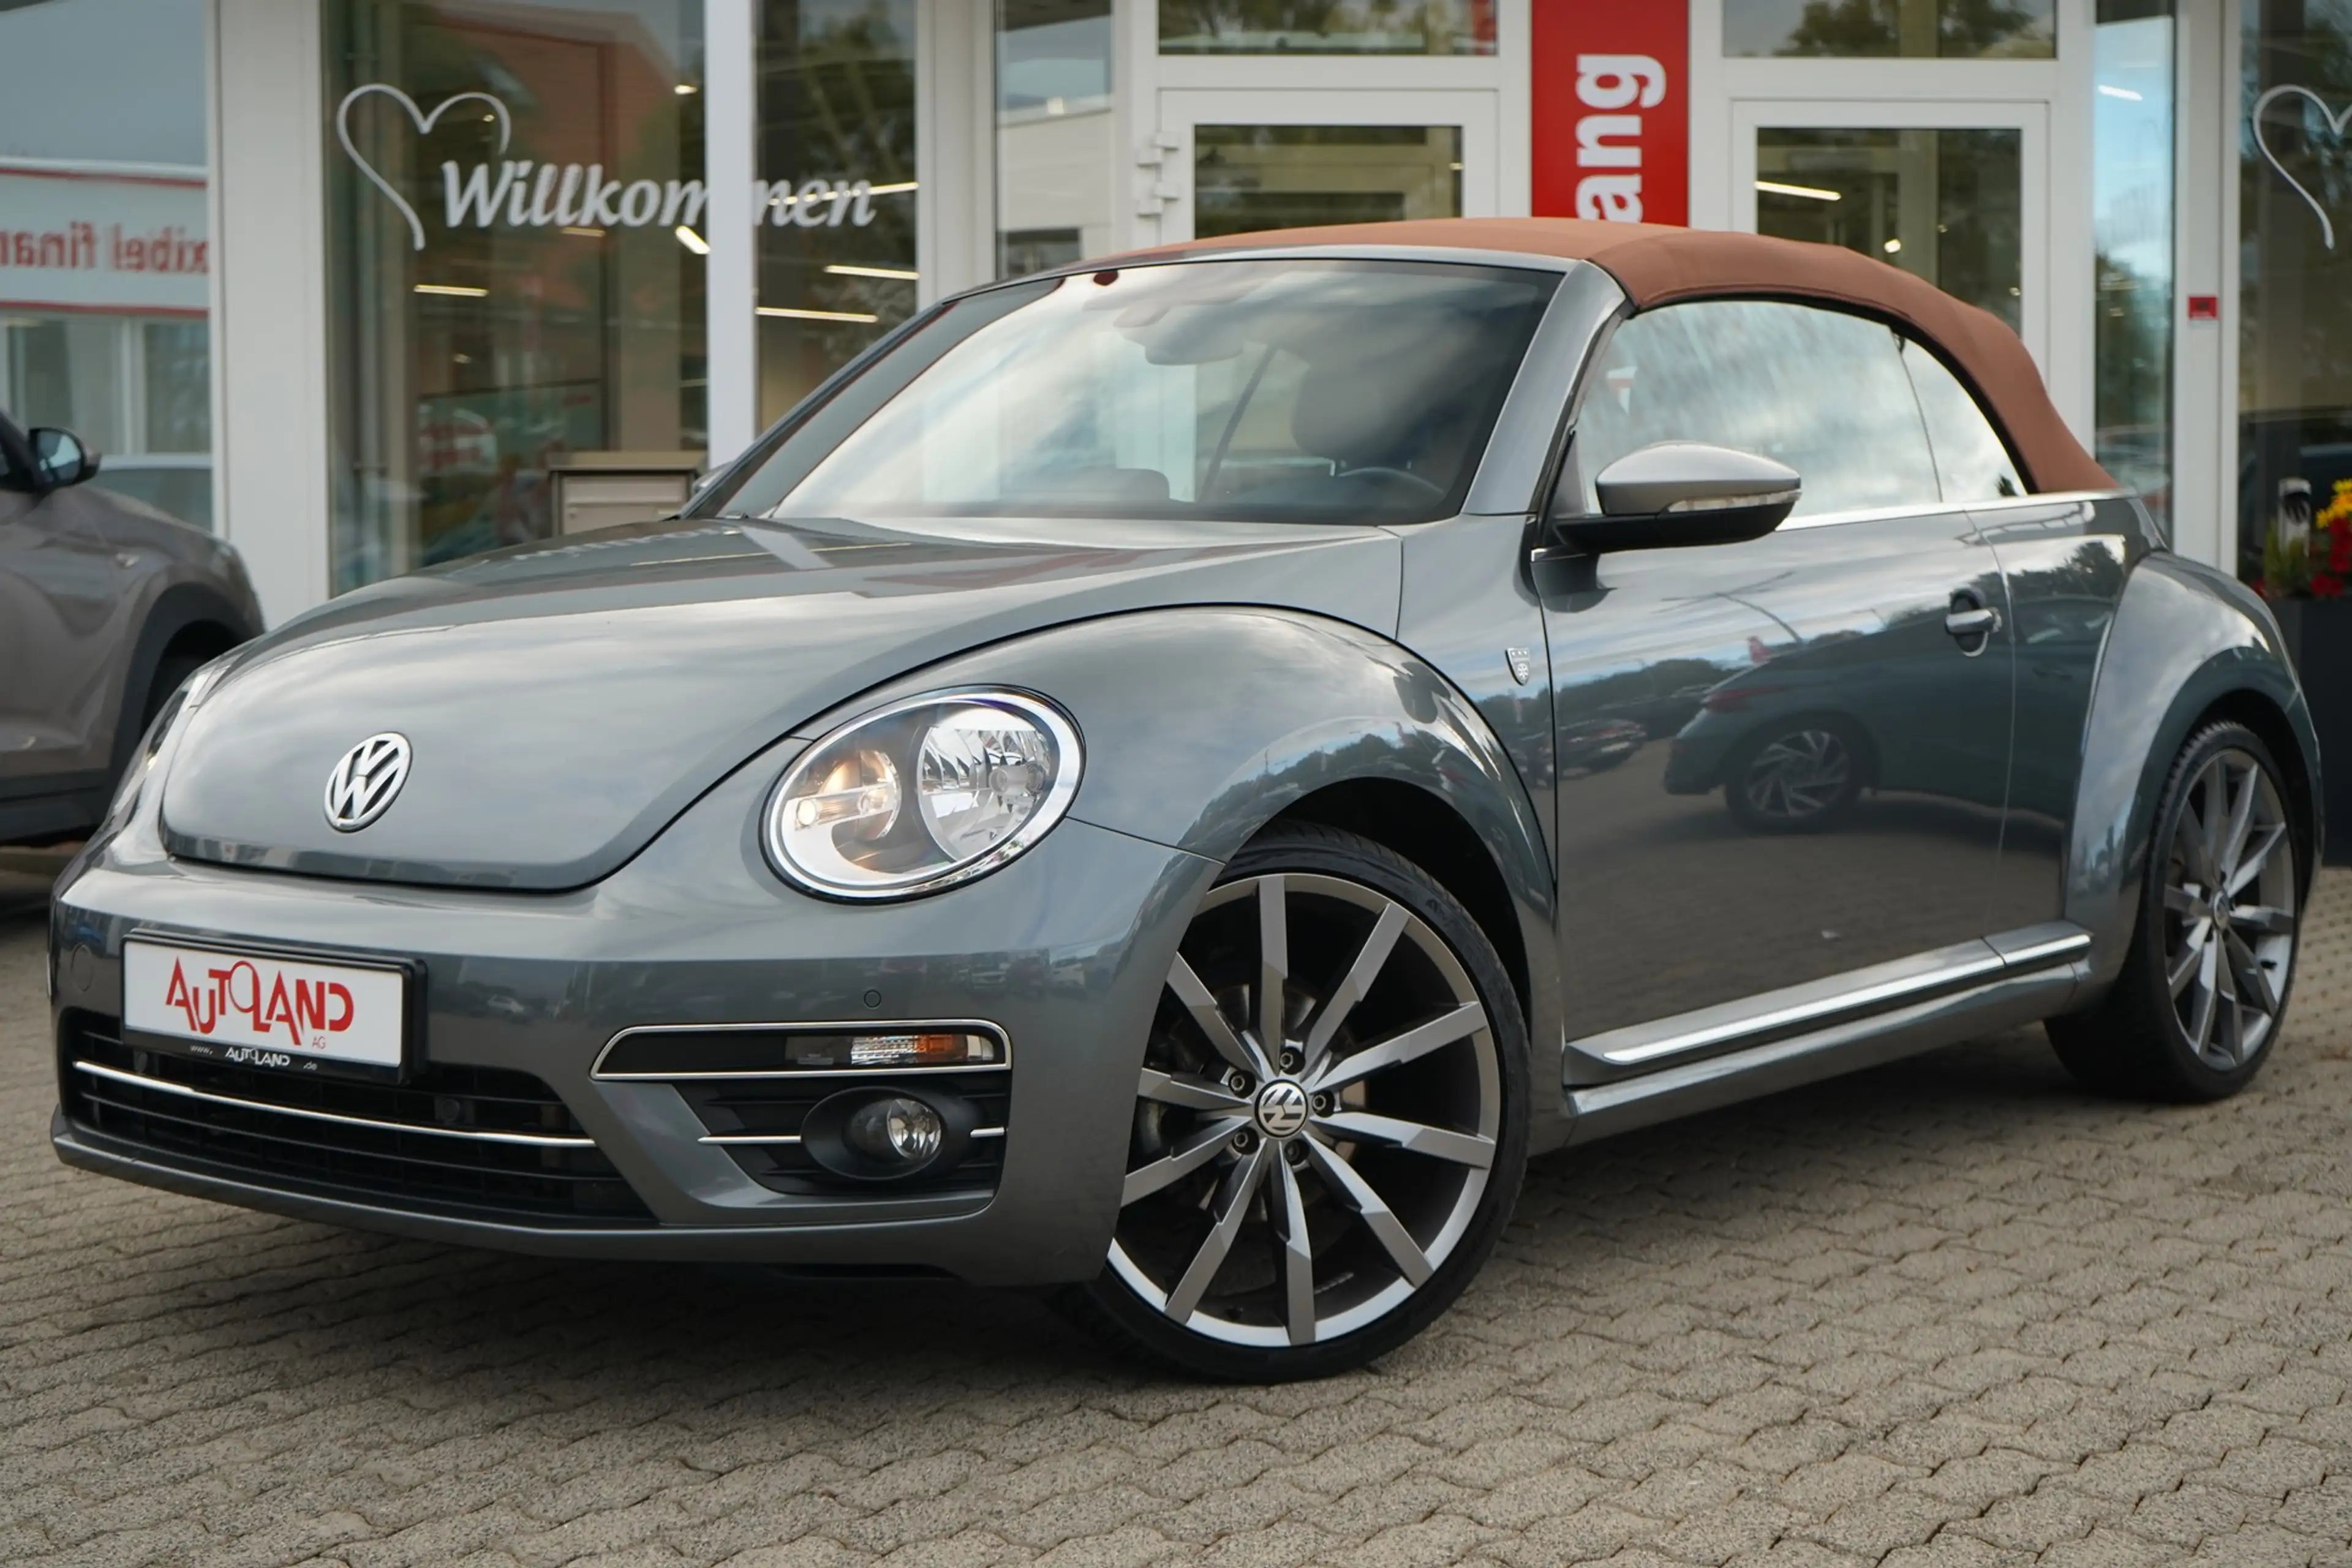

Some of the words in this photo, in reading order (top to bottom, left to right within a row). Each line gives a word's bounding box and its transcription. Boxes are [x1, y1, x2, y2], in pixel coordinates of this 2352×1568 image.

[1575, 54, 1666, 222] ang
[324, 733, 412, 831] VW
[312, 1036, 326, 1049] AG
